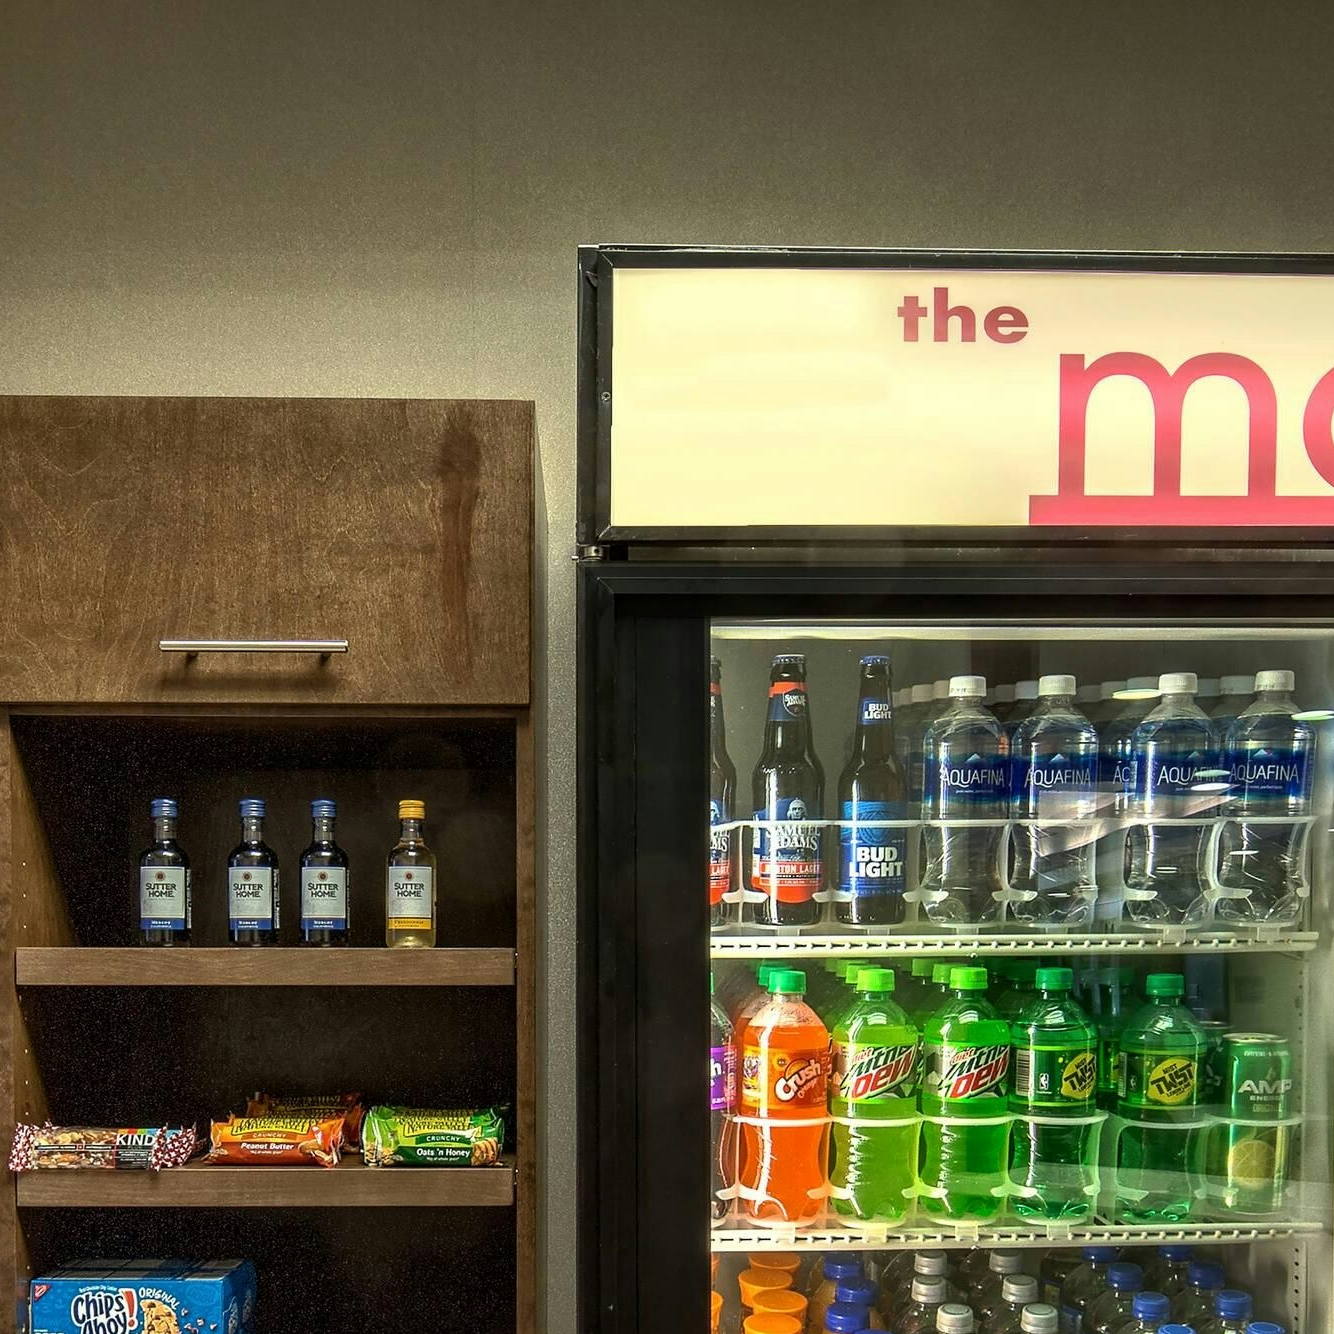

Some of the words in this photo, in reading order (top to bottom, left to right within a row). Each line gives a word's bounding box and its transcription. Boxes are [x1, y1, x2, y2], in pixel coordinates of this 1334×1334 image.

[897, 286, 1029, 345] the
[868, 703, 889, 711] BUD
[864, 711, 891, 720] LIGHT
[940, 768, 1005, 788] AQUAFINA
[1024, 767, 1091, 788] AQUAFINA
[1229, 764, 1299, 784] AQUAFINA
[856, 847, 898, 862] BUD
[849, 862, 903, 878] LIGHT
[145, 883, 176, 891] SUTTER
[233, 883, 263, 891] SUTTER
[307, 883, 338, 891] SUTTER
[394, 883, 425, 891] SUTTER
[148, 890, 174, 898] HOME
[236, 890, 261, 898] HOME
[311, 890, 336, 898] HOME
[397, 890, 422, 898] HOME
[775, 1058, 823, 1100] Crush
[1064, 1056, 1097, 1091] TWIST
[1150, 1062, 1195, 1096] TWIST
[1238, 1079, 1292, 1095] AMP
[117, 1134, 156, 1146] KIND
[416, 1148, 434, 1156] Oats
[445, 1148, 470, 1158] Honey
[139, 1287, 181, 1310] ORIGINAL
[72, 1292, 125, 1324] Chips
